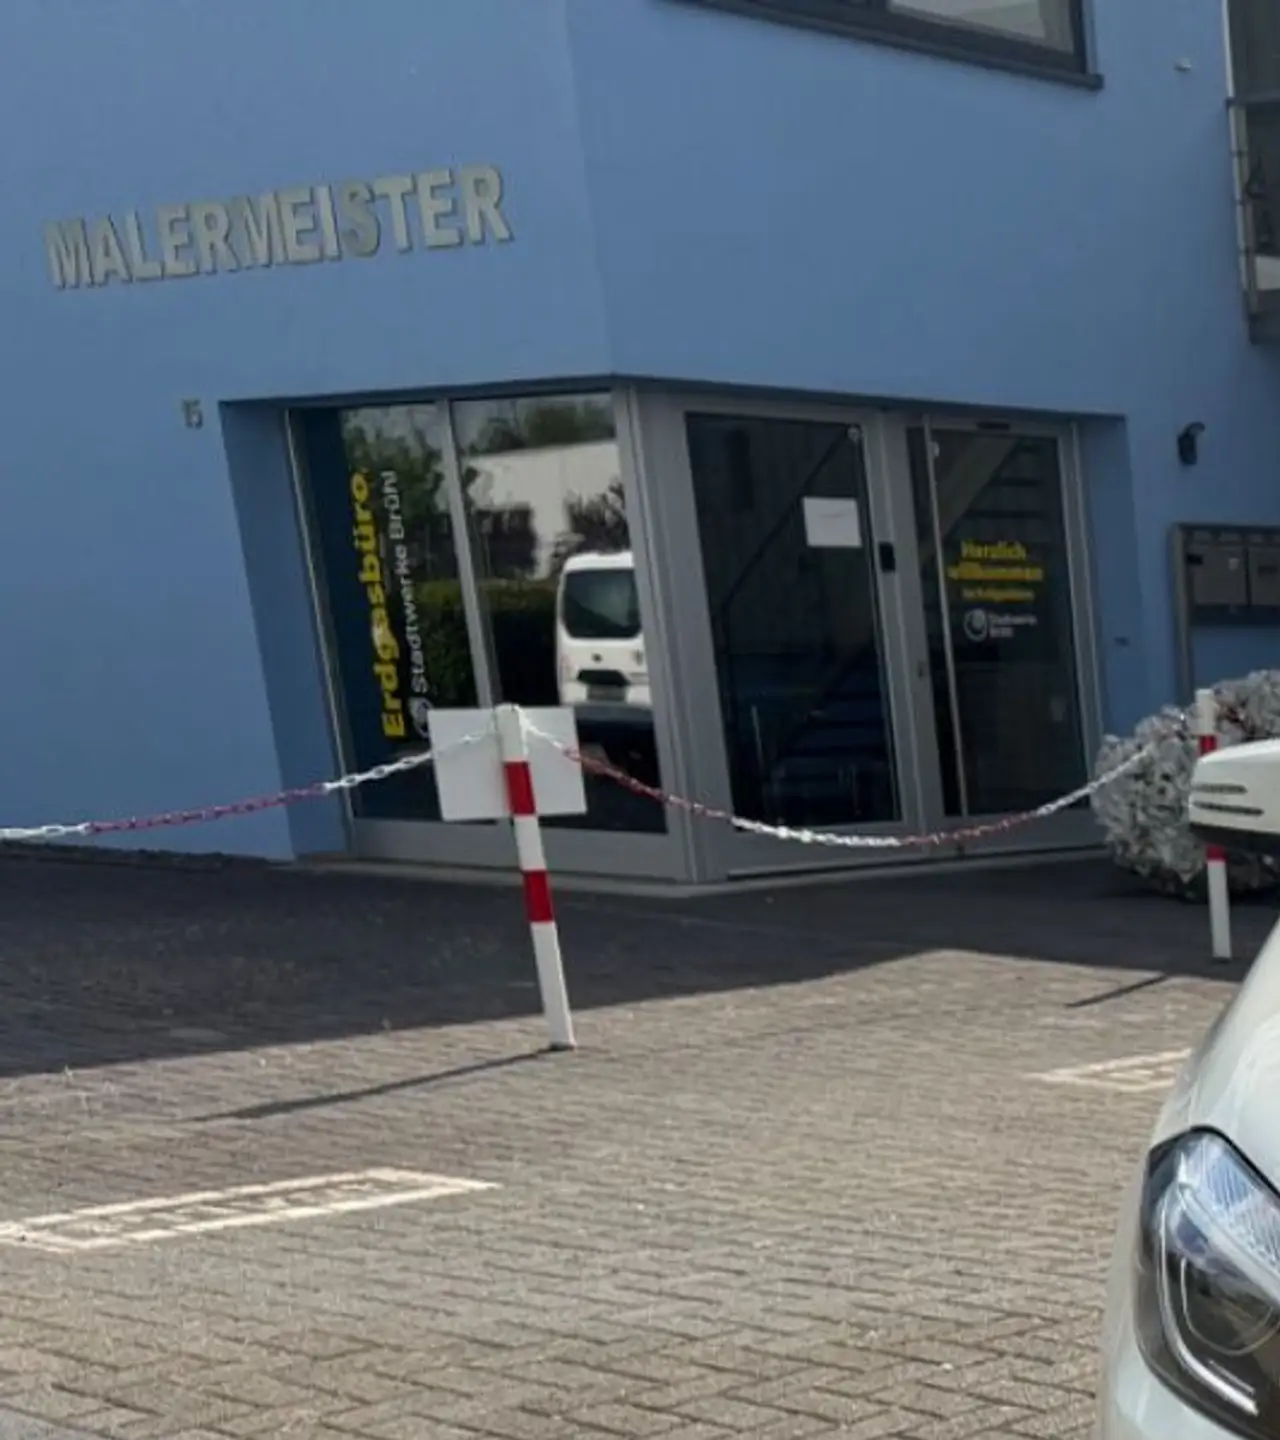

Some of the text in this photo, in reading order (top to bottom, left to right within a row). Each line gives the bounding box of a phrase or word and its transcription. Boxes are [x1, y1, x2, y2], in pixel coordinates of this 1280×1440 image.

[44, 163, 515, 289] MALERMEISTER
[350, 468, 406, 738] Erdgasbüro
[392, 545, 429, 693] Stadtwerke
